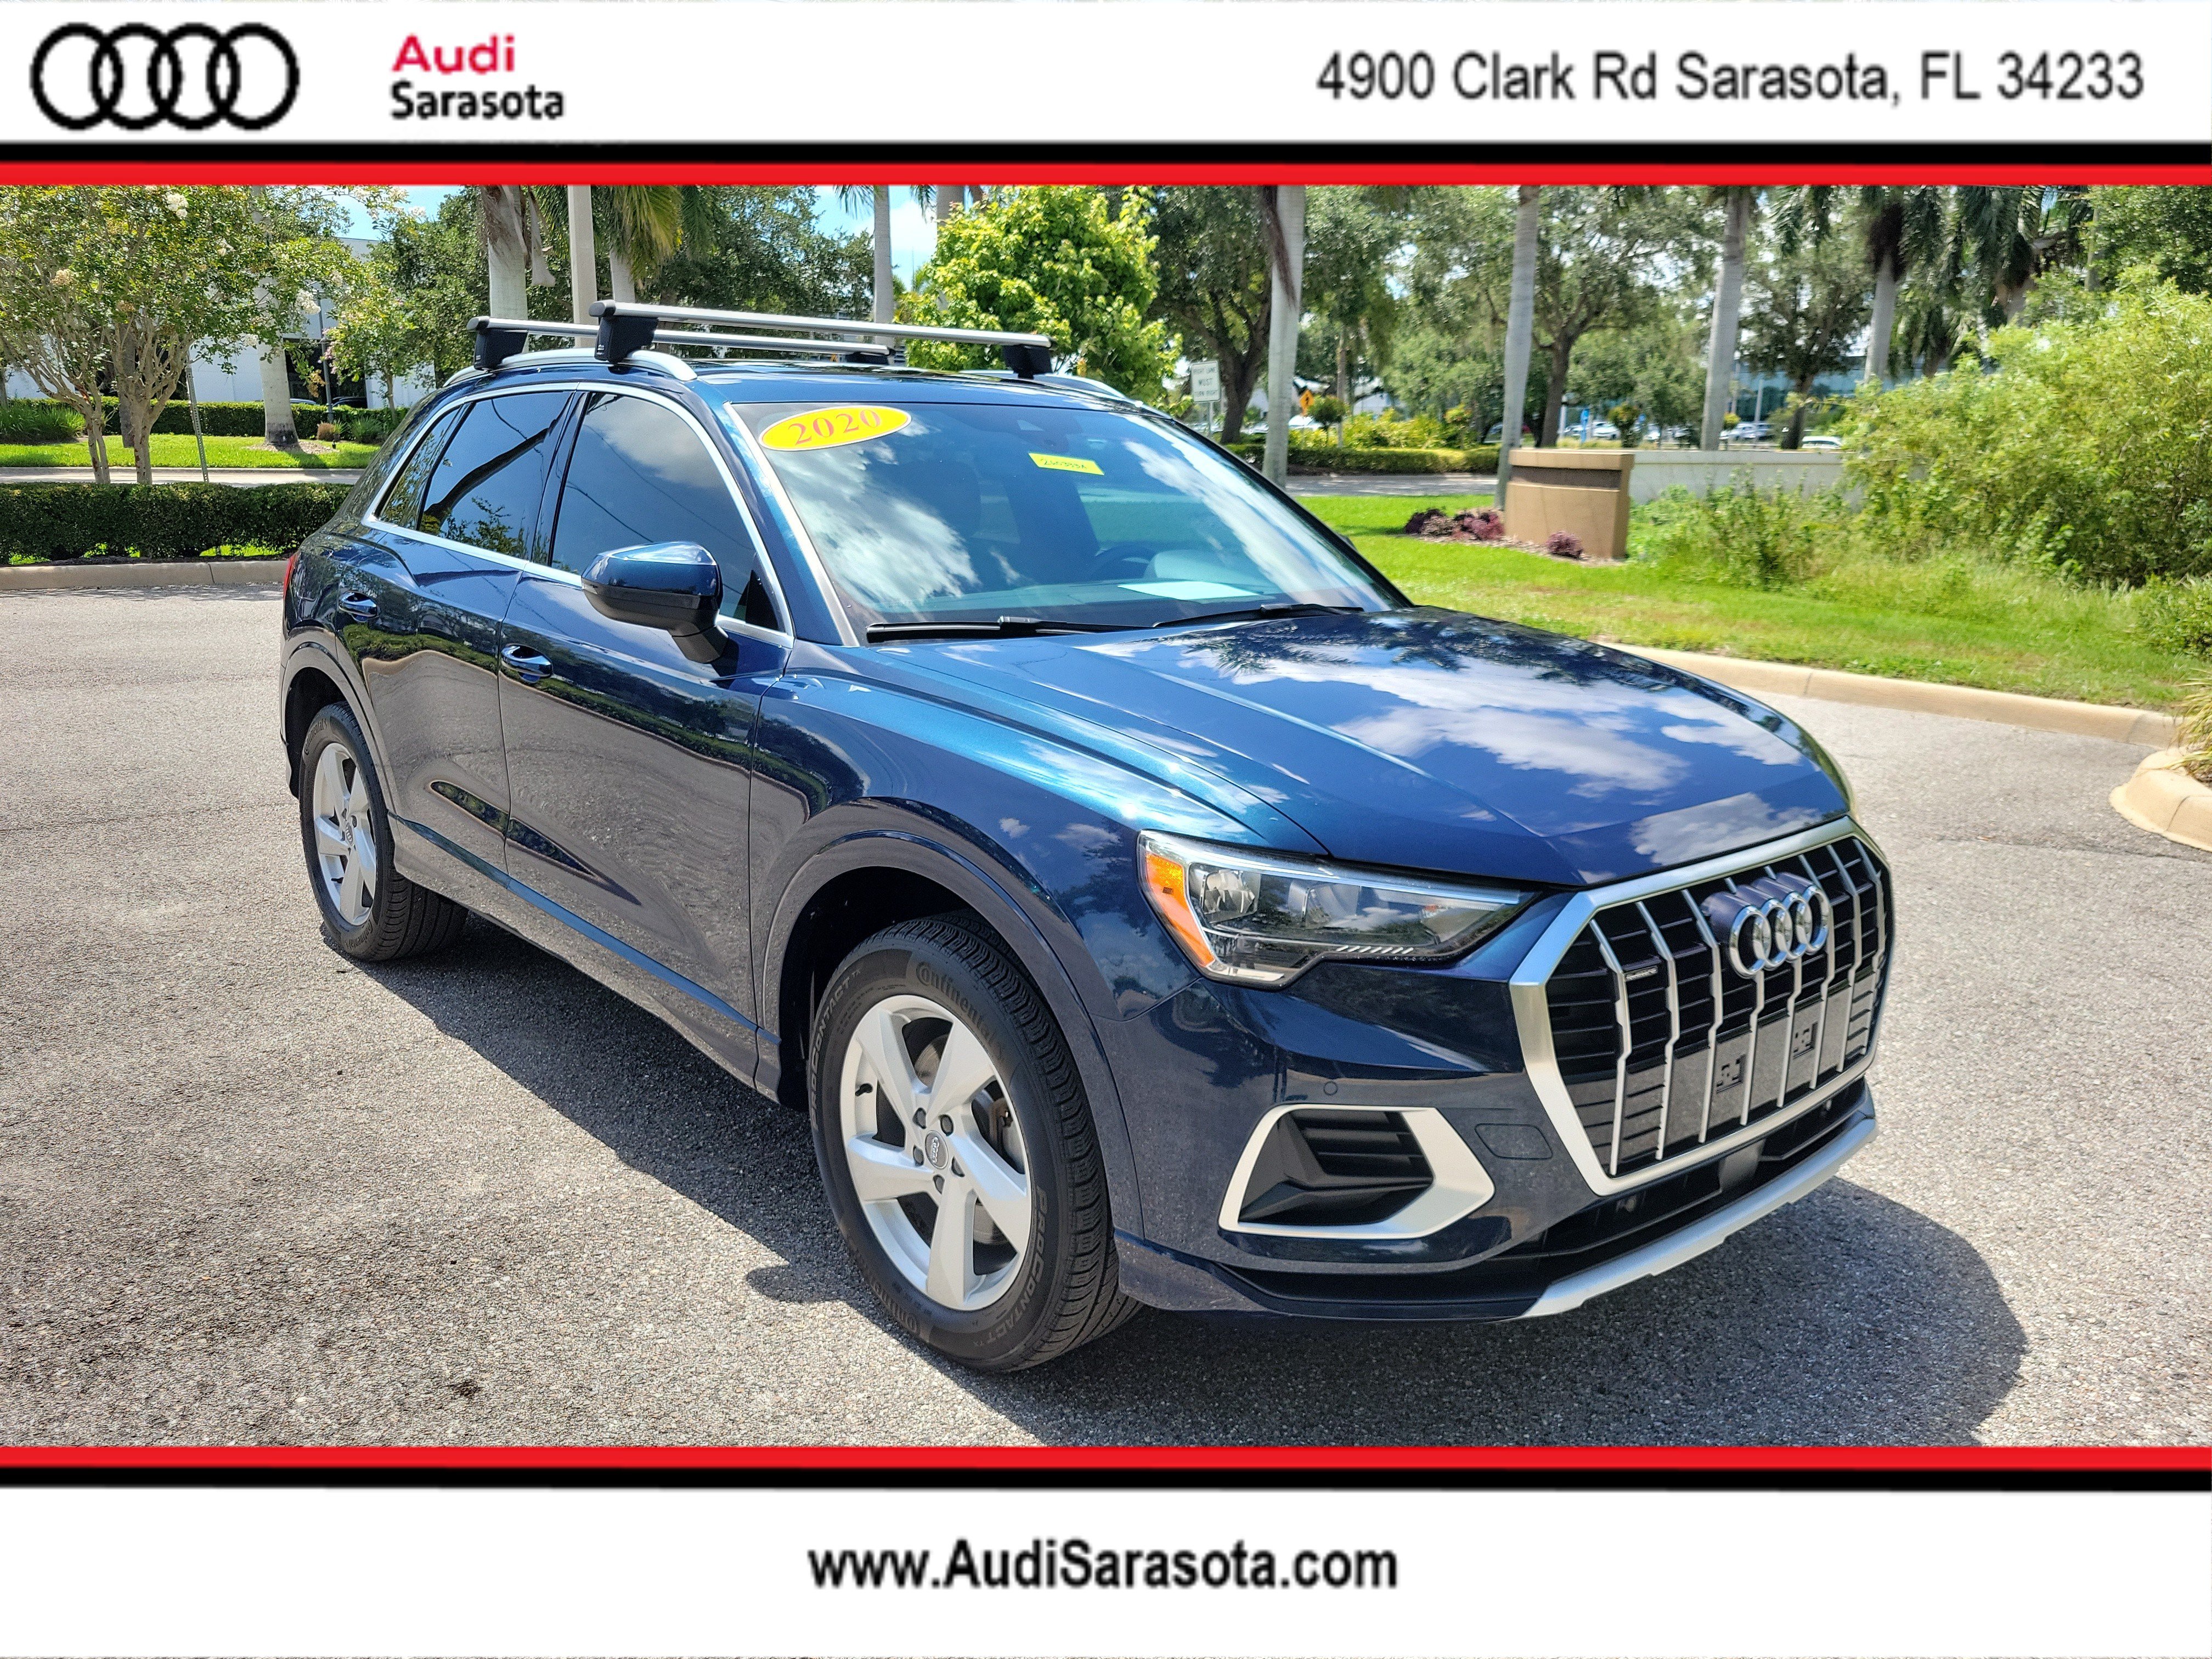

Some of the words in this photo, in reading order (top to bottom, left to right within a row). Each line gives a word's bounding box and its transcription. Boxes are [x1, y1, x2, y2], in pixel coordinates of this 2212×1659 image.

[788, 409, 881, 446] 2020
[916, 961, 996, 1047] Continental
[987, 1185, 1047, 1345] PROCONTACT
